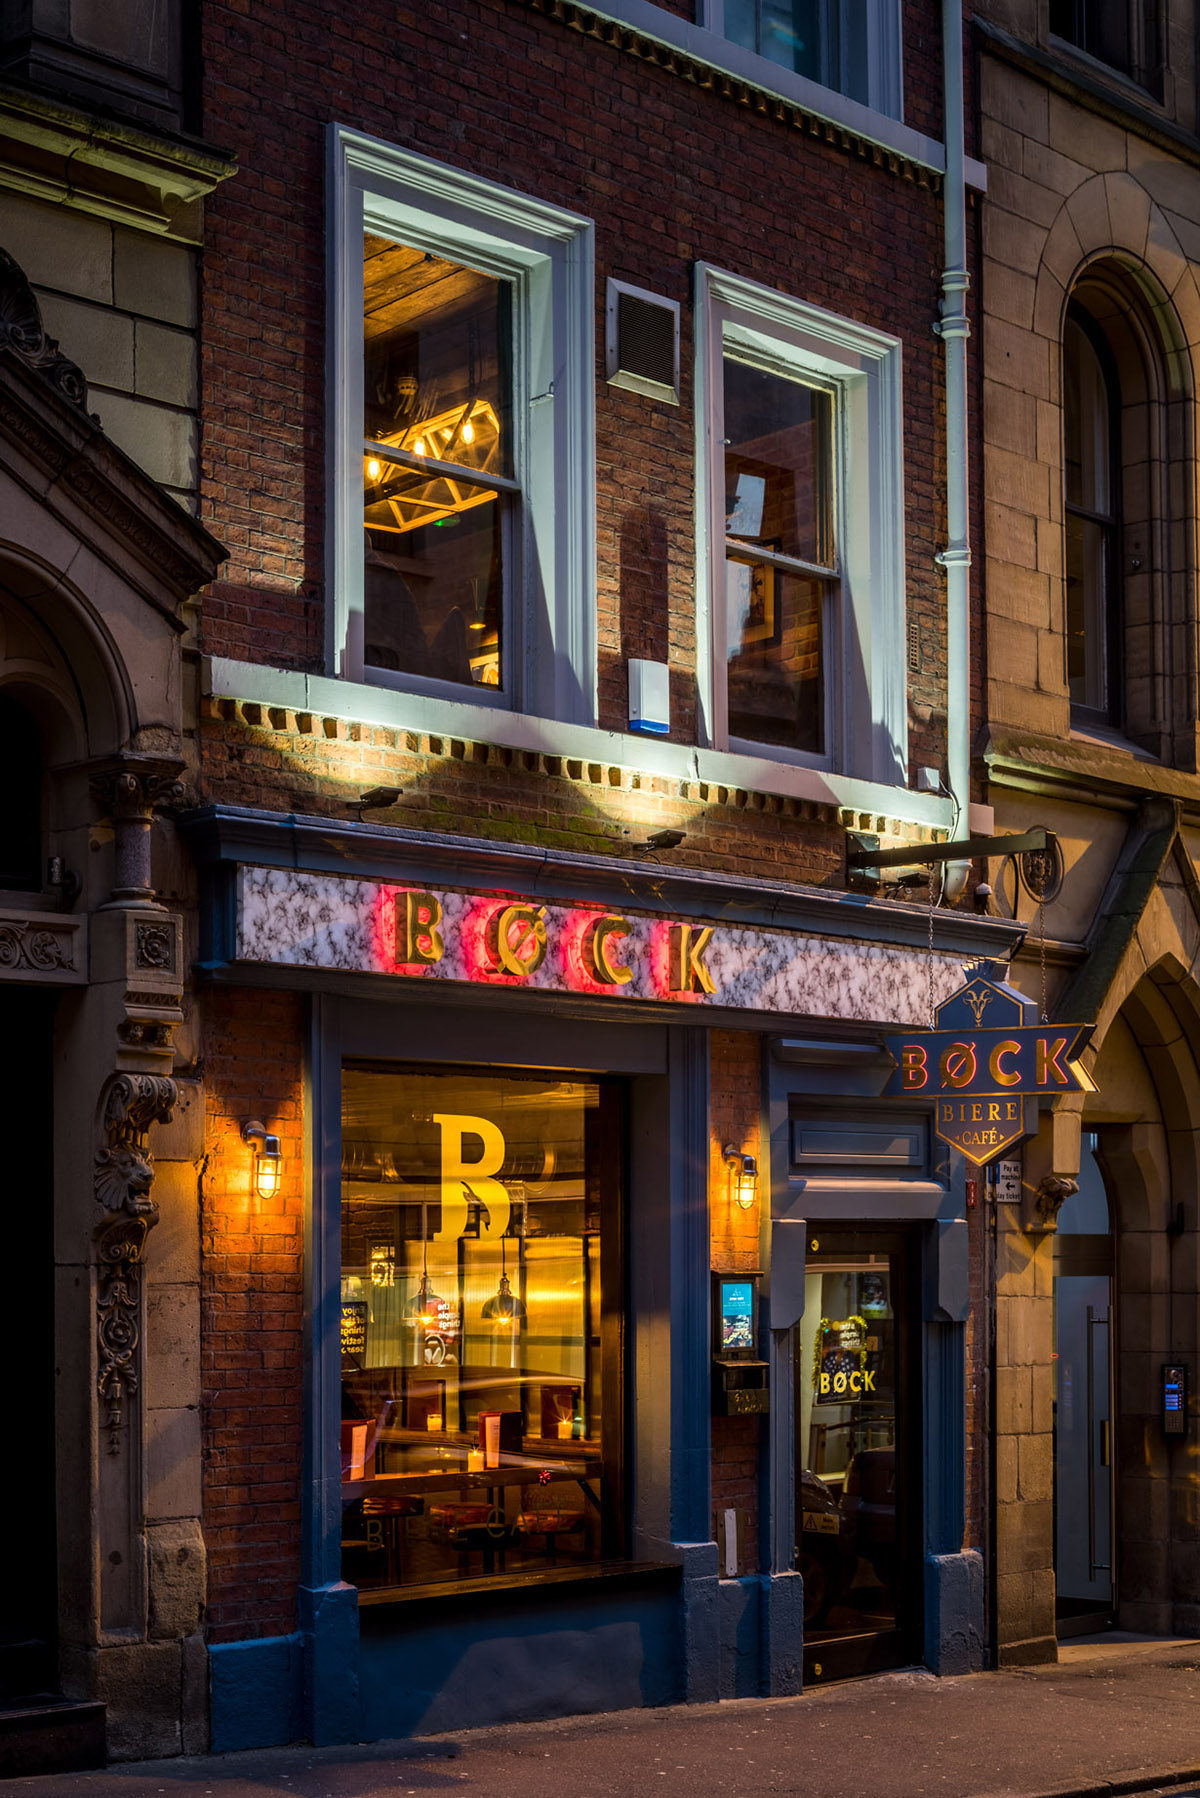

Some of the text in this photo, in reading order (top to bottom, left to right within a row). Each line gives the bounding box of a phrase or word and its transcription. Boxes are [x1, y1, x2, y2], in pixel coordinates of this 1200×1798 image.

[902, 1038, 1068, 1089] BØCK
[942, 1102, 1018, 1122] BIERE
[962, 1127, 998, 1145] CAFÉ
[820, 1370, 876, 1394] BØCK
